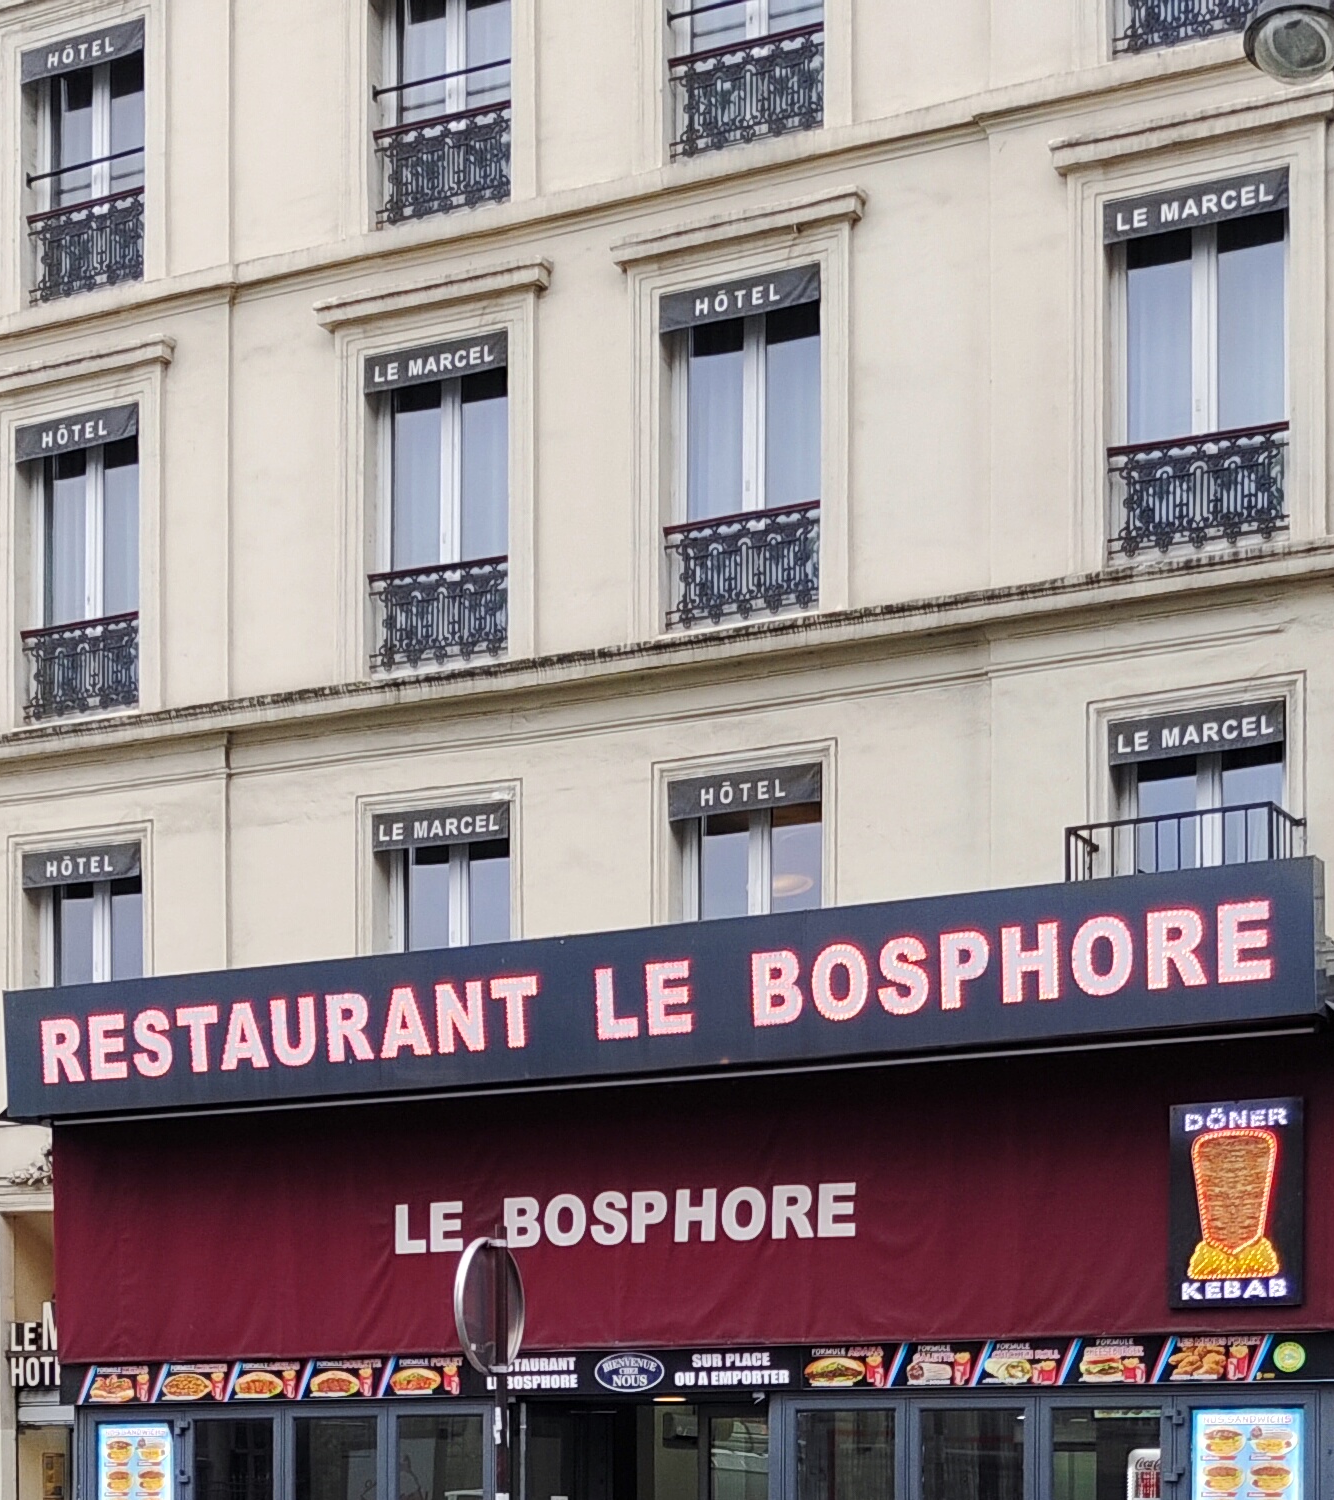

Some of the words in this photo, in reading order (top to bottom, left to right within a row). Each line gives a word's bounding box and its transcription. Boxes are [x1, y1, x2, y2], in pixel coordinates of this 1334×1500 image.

[47, 37, 115, 69] HÔTEL
[1116, 206, 1148, 231] LE
[1159, 184, 1274, 223] MARCEL
[694, 282, 781, 316] HÔTEL
[373, 361, 399, 384] LE
[408, 344, 495, 377] MARCEL
[41, 418, 108, 450] HÔTEL
[1117, 730, 1149, 754] LE
[1161, 715, 1273, 748] MARCEL
[700, 778, 786, 807] HÔTEL
[379, 822, 405, 842] LE
[414, 814, 499, 838] MARCEL
[46, 854, 113, 877] HÔTEL
[39, 974, 538, 1084] RESTAURANT
[594, 960, 694, 1041] LE
[751, 899, 1273, 1028] BOSPHORE
[1184, 1108, 1288, 1131] DÖNER
[395, 1201, 464, 1254] LE
[503, 1182, 856, 1249] BOSPHORE
[1181, 1278, 1288, 1300] KEBAB
[10, 1322, 36, 1351] LE
[602, 1356, 657, 1373] BIENVENUE
[692, 1353, 722, 1368] SUR
[725, 1352, 770, 1367] PLACE
[612, 1374, 648, 1387] NOUS
[674, 1372, 695, 1386] OU
[697, 1372, 709, 1385] A
[711, 1370, 790, 1386] EMPORTER
